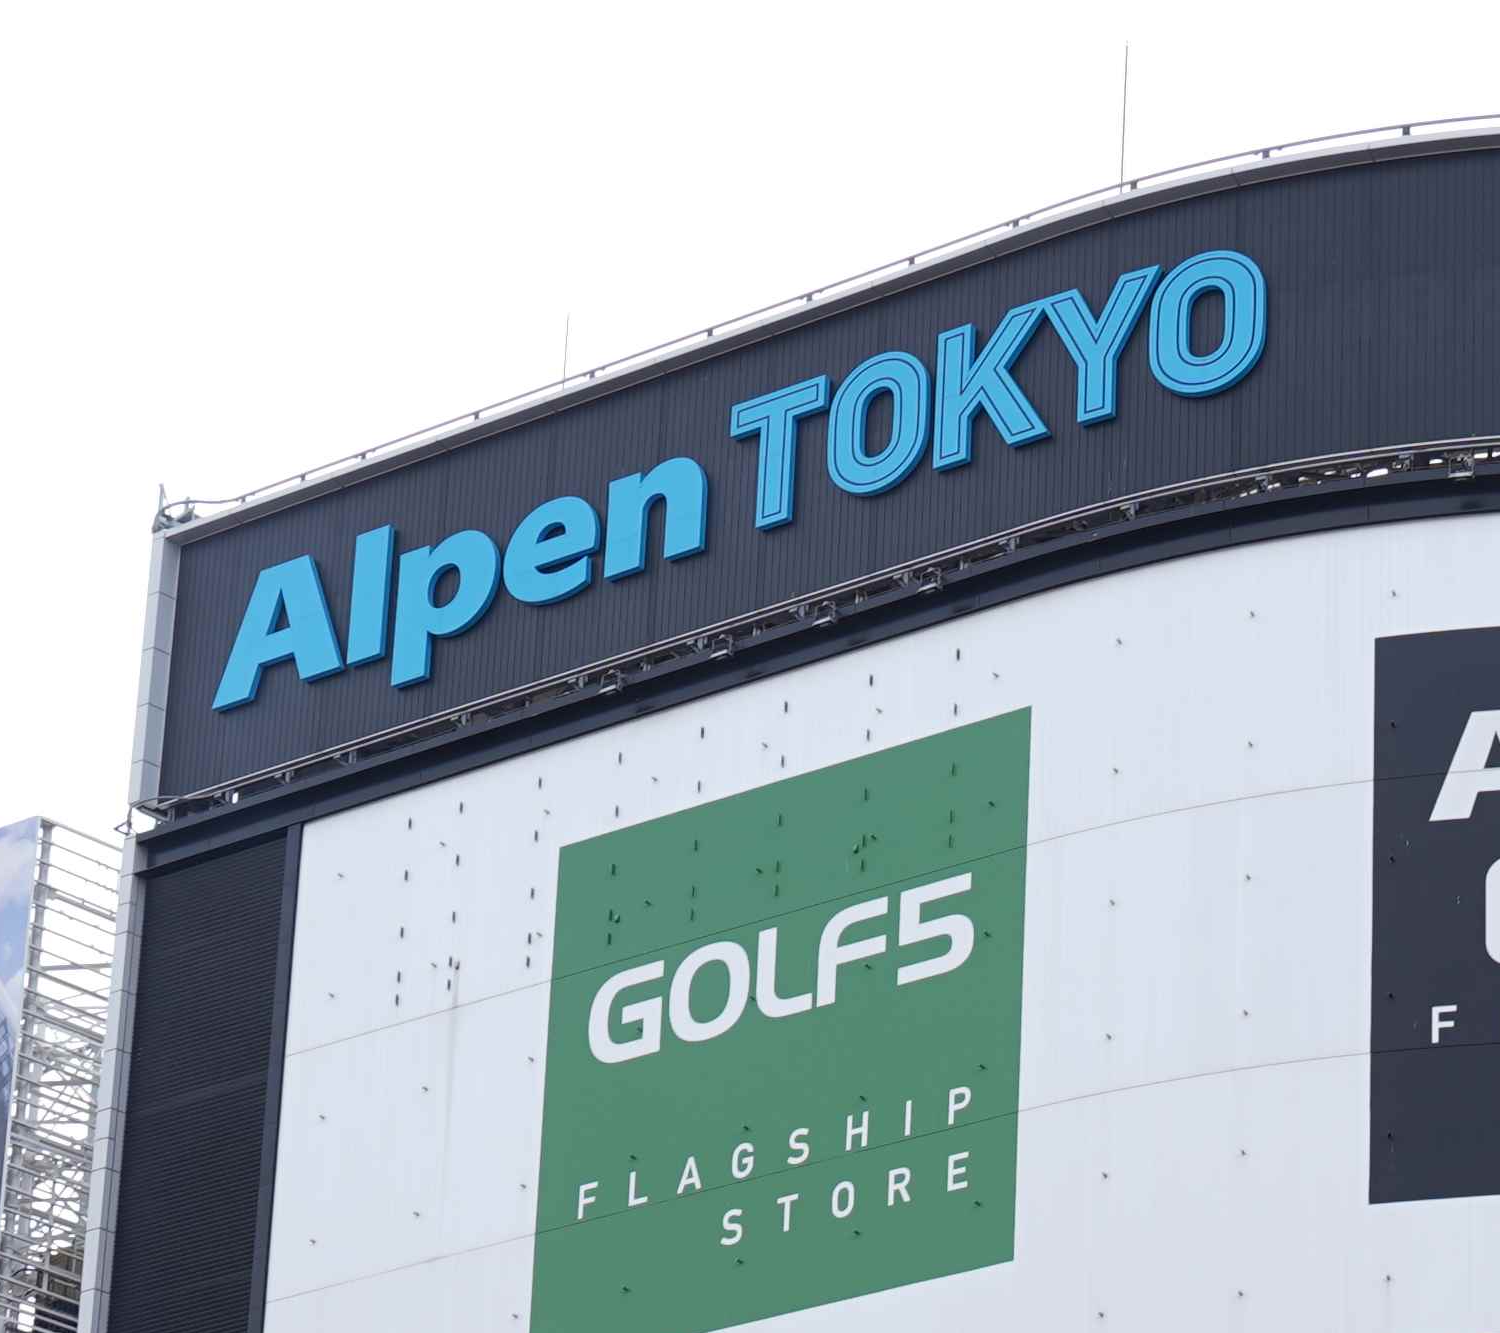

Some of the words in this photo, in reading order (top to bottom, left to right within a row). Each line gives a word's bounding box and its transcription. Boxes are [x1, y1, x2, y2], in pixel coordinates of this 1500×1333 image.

[212, 456, 708, 712] Alpen
[731, 250, 1266, 530] TOKYO
[587, 872, 976, 1064] GOLF5
[577, 1086, 973, 1220] FLAGSHIP
[720, 1151, 971, 1246] STORE
